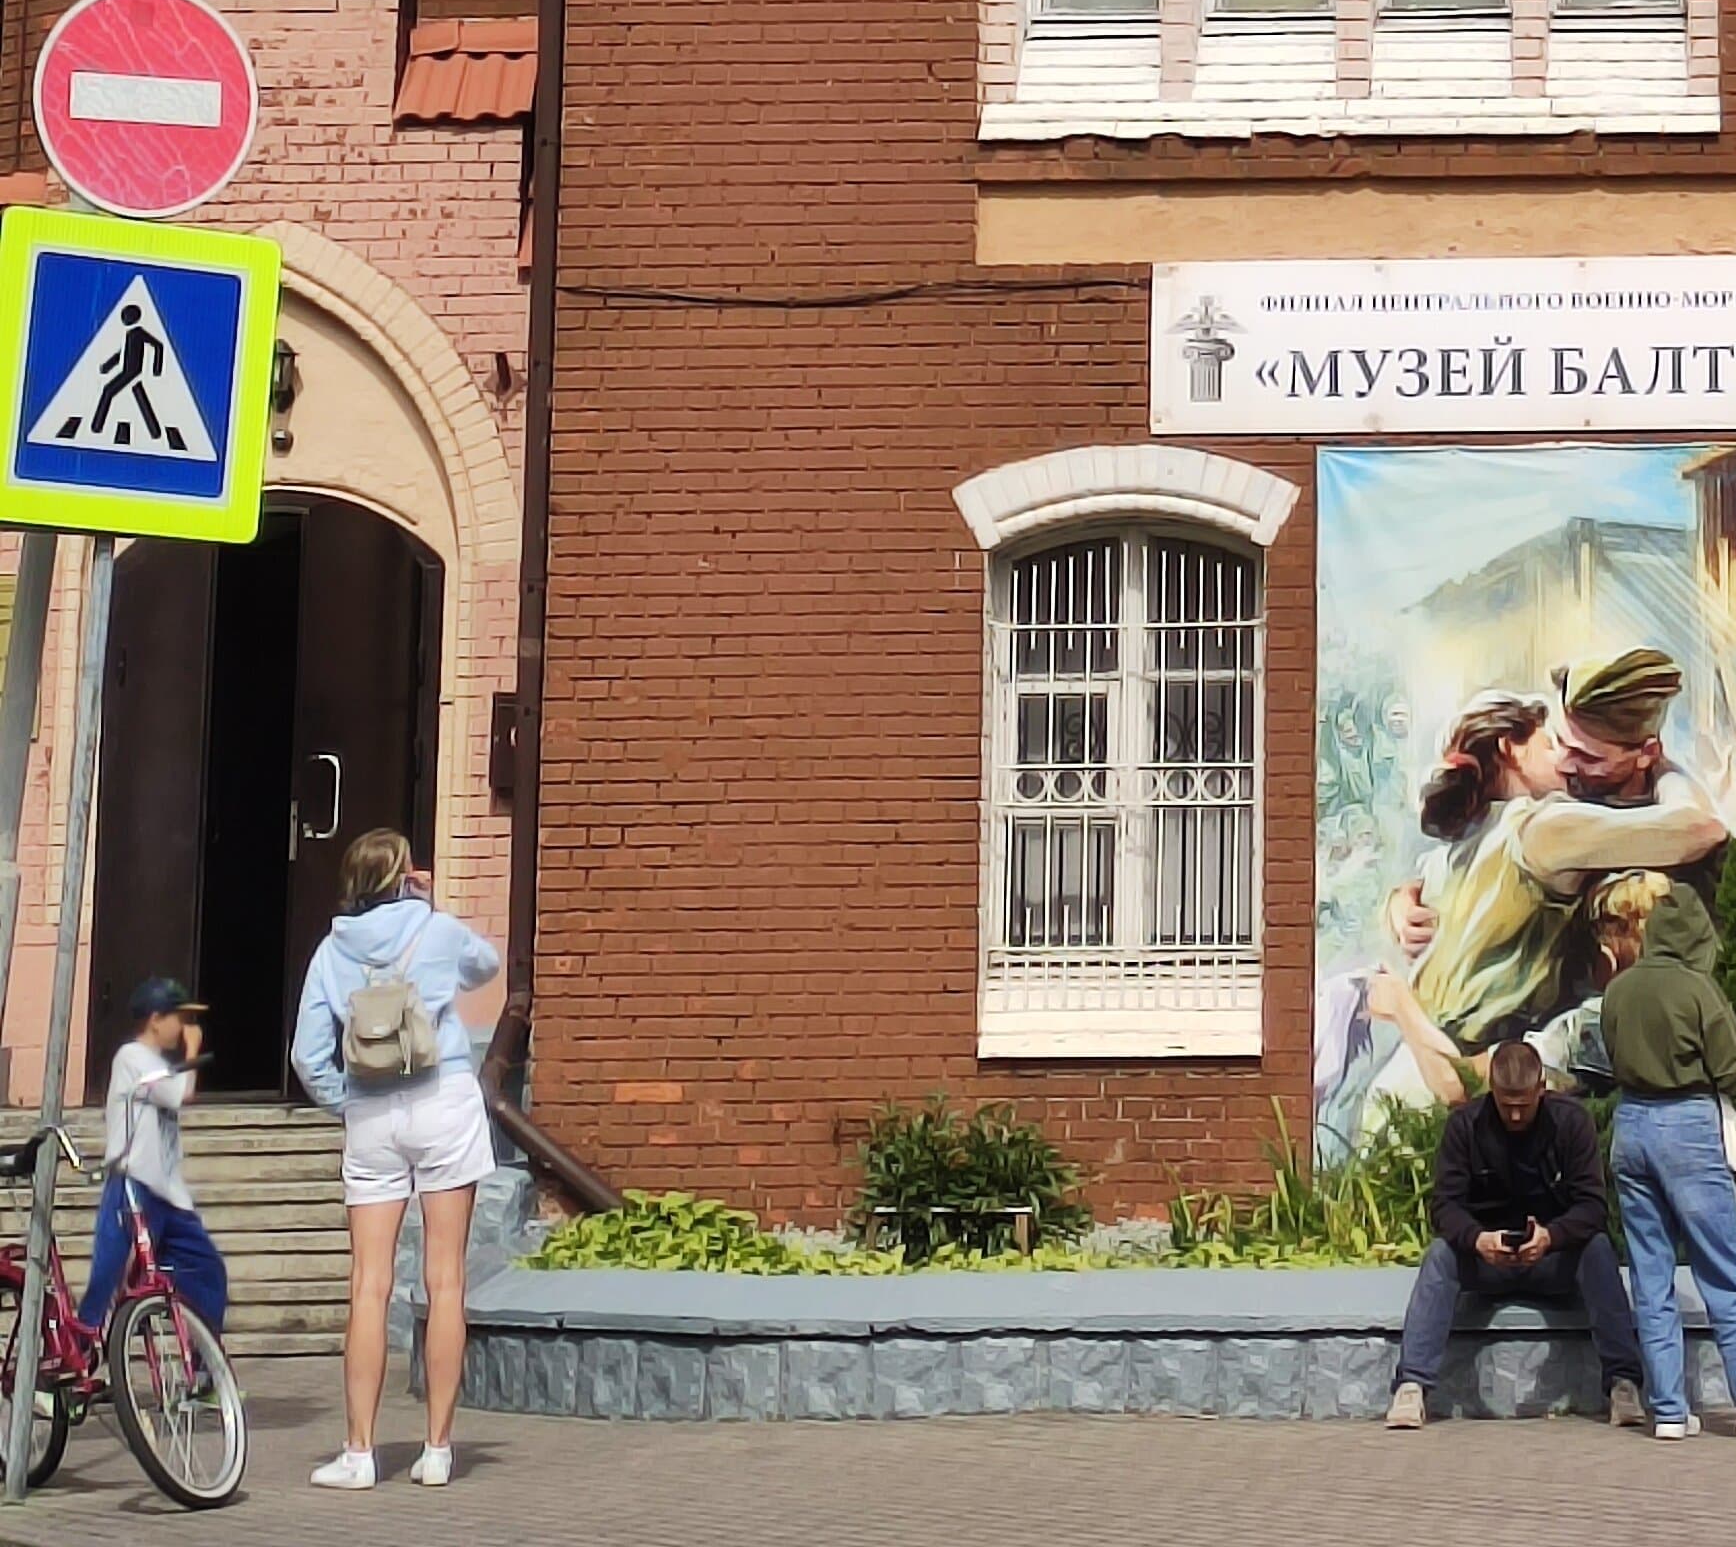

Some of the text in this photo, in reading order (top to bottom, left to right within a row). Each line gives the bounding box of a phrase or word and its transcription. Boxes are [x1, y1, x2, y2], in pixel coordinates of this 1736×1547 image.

[1261, 294, 1363, 311] ФИЛИАЛ
[1372, 292, 1562, 312] ЦЕНТРАЛЬНОГО
[1255, 336, 1528, 398] «МУЗЕЙ
